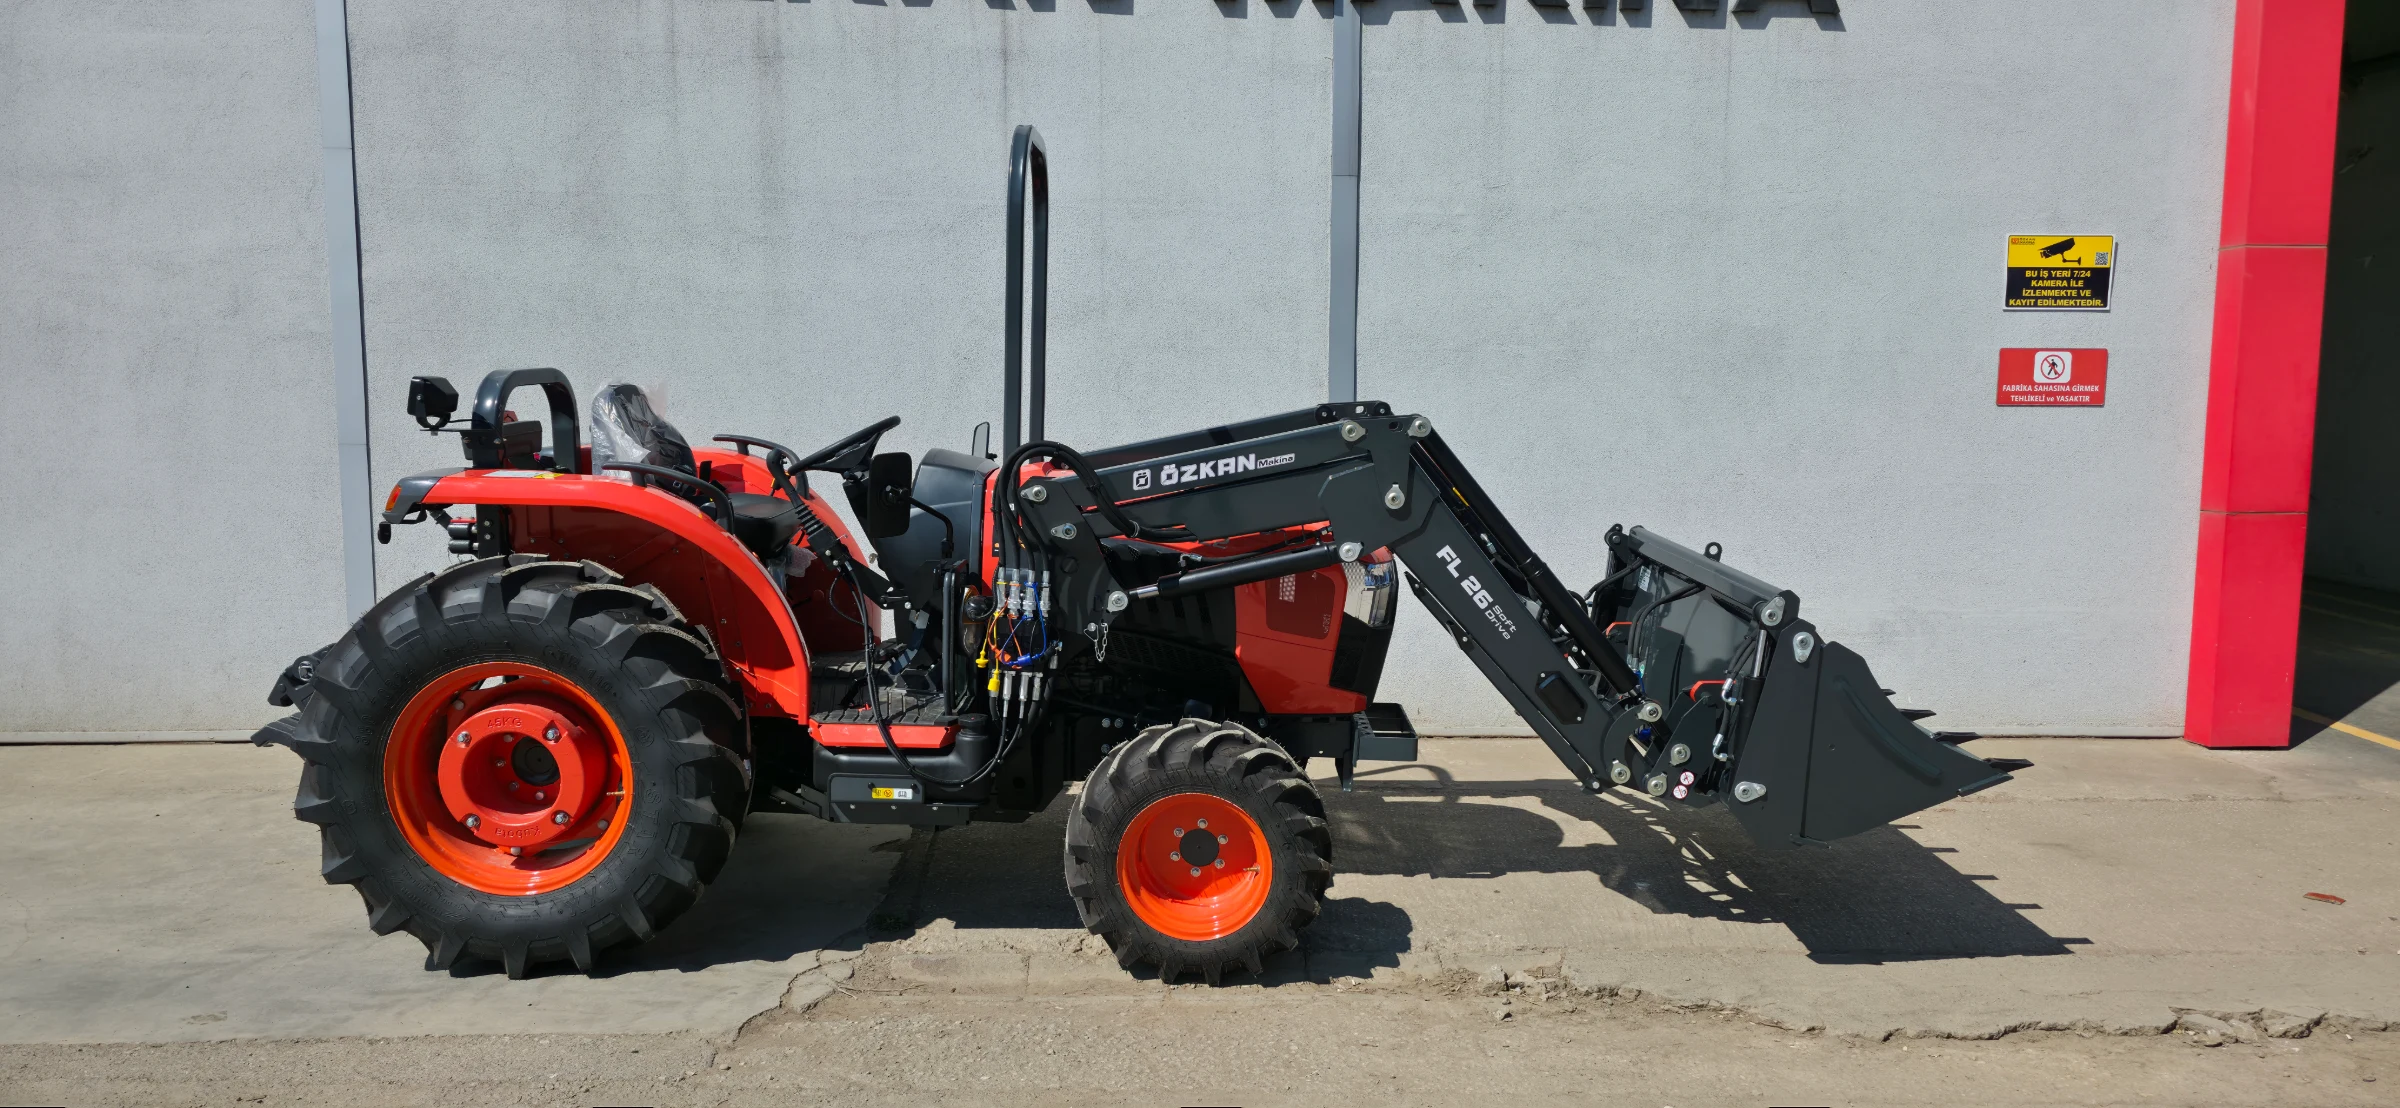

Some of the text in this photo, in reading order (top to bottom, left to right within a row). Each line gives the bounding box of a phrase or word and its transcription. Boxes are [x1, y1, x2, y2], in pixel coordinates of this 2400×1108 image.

[2025, 268, 2091, 279] BU İŞ YERİ 7/24
[2031, 278, 2084, 287] KAMERA İLE
[2022, 288, 2091, 297] İZLENMEKTE VE
[2037, 297, 2104, 306] EDİLMEKTEDİR.
[2002, 383, 2100, 392] FABRİKA SAHASINA GİRMEK
[2010, 393, 2046, 402] TEHLİKELİ
[1160, 453, 1294, 486] ÖZKAN Makina
[1435, 544, 1494, 610] FL 26
[1492, 604, 1517, 633] Soft
[1484, 609, 1511, 640] Drive
[495, 825, 541, 838] Kubota
